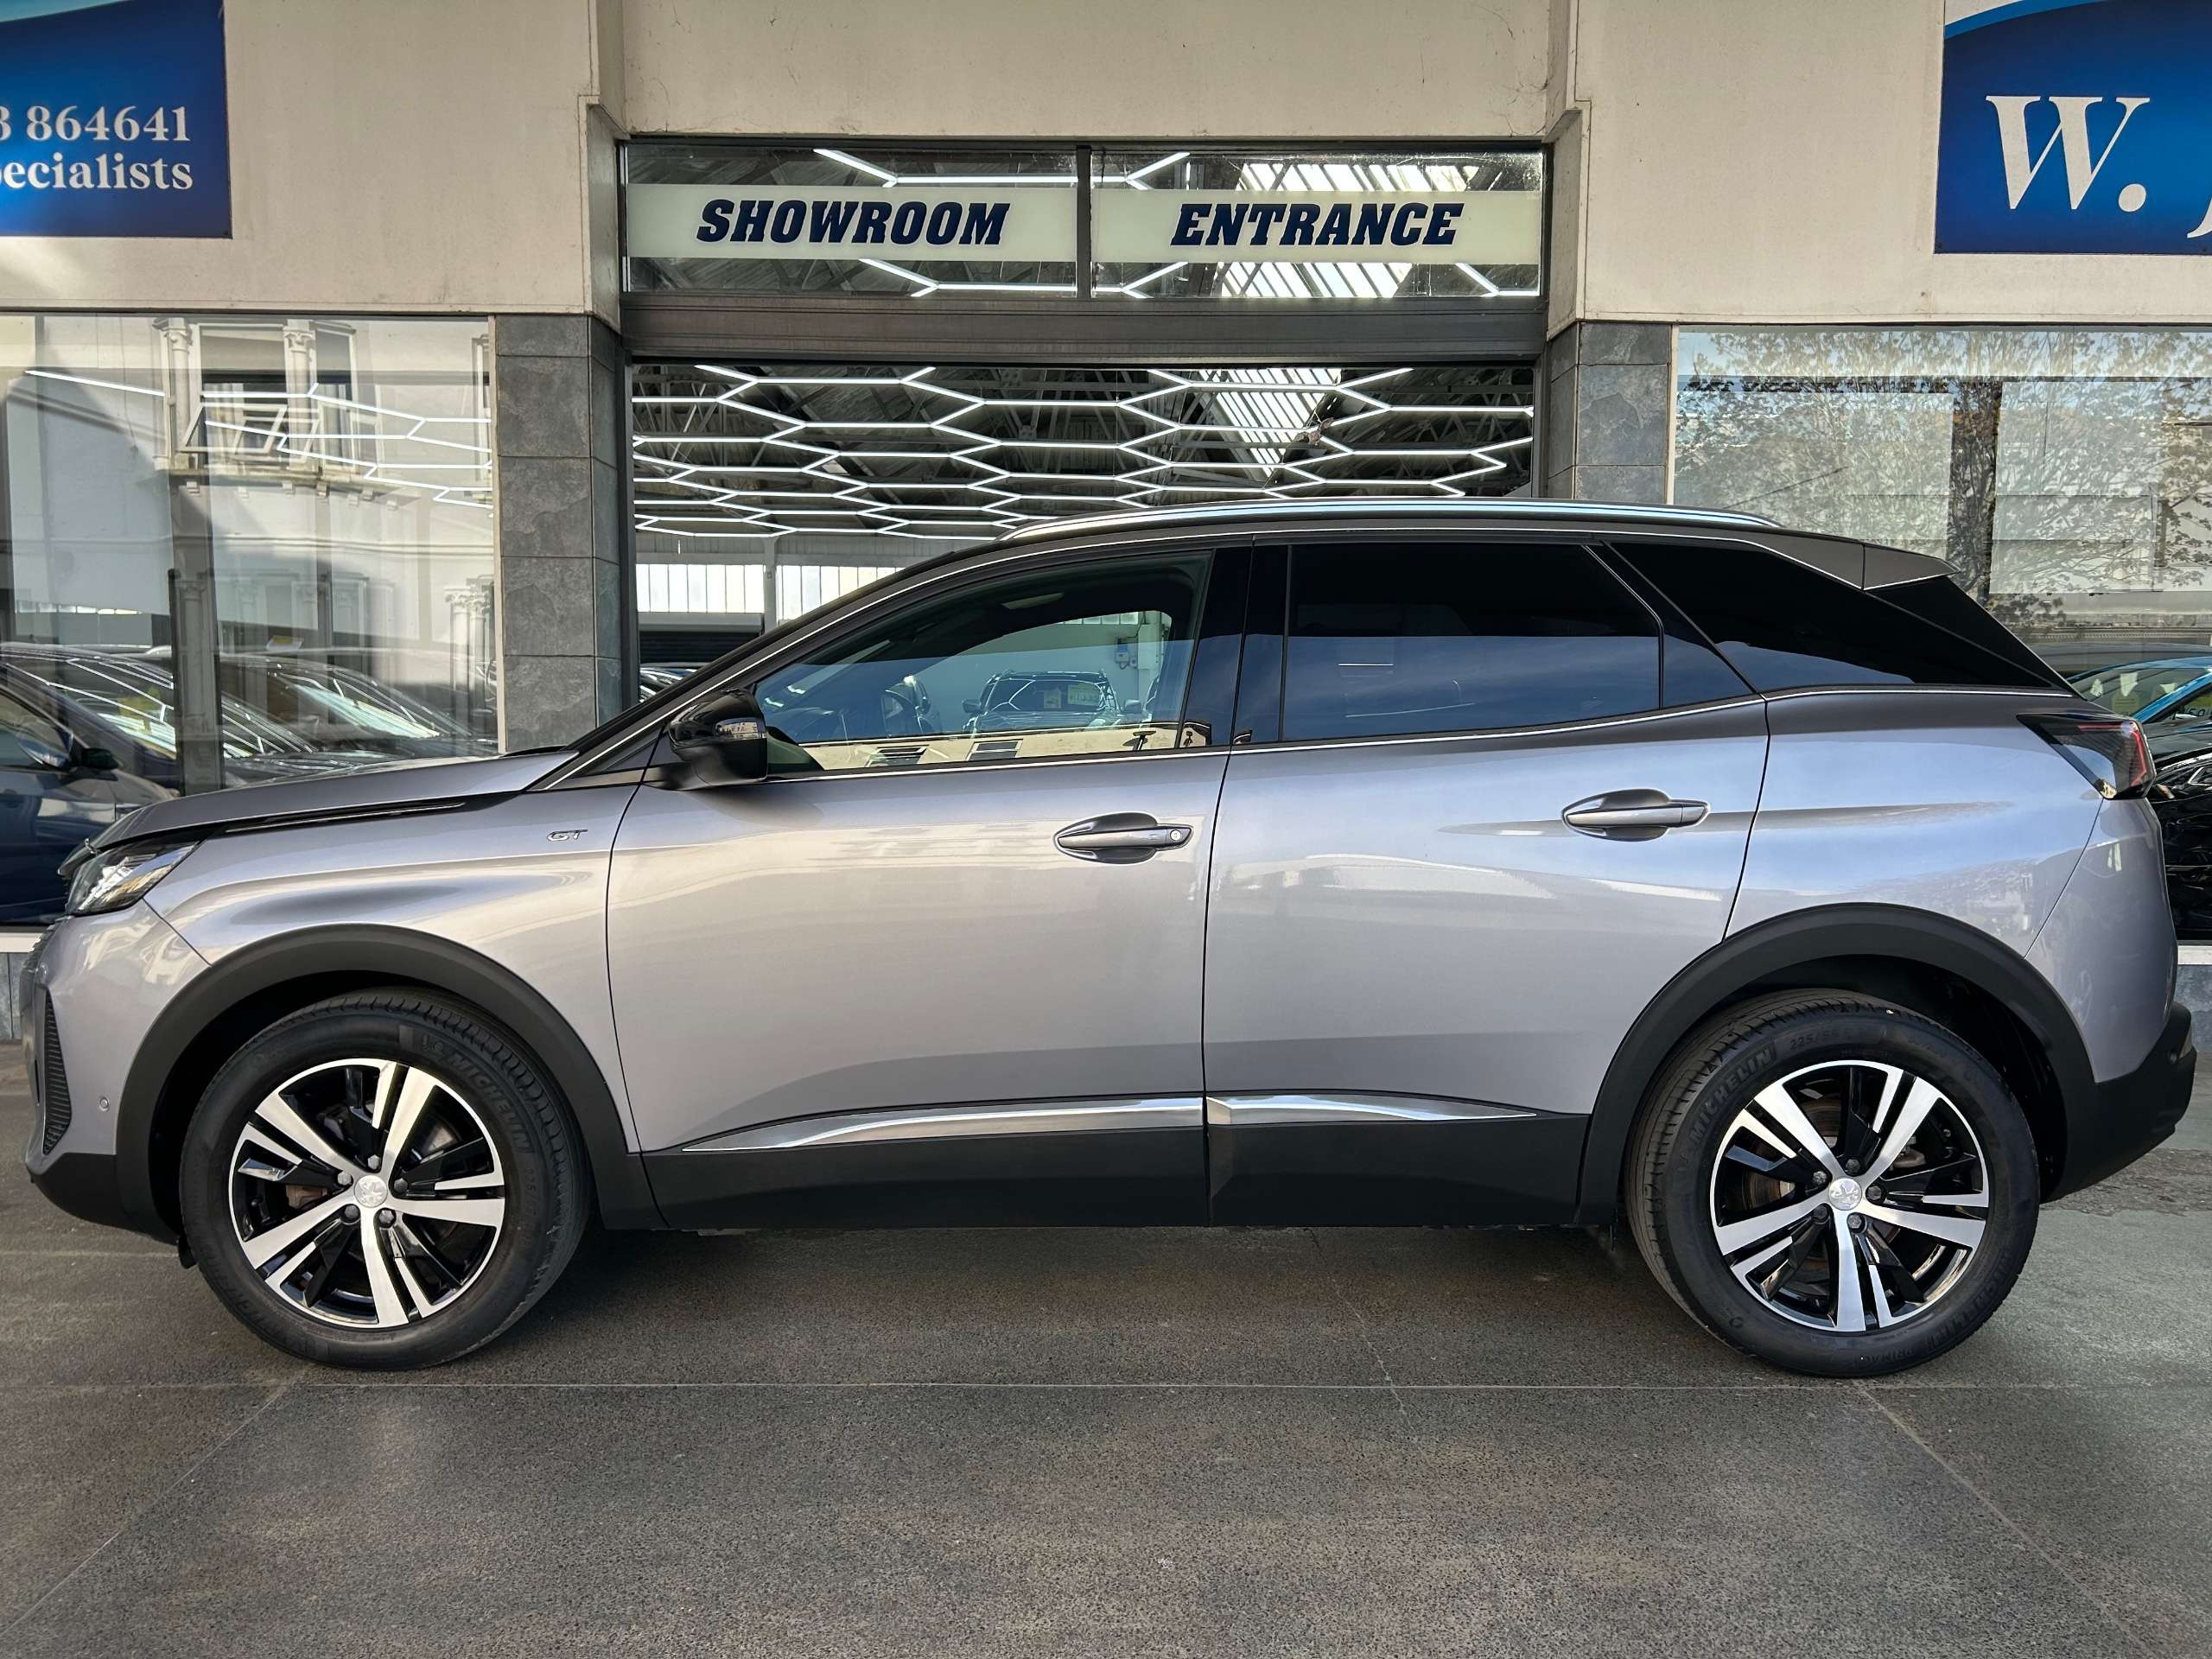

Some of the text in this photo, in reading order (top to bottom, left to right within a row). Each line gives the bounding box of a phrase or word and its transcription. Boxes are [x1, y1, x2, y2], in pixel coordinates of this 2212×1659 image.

[26, 105, 190, 142] 864641
[0, 152, 194, 189] ecialists
[1986, 95, 2151, 213] W.
[696, 199, 1465, 246] SHOWROOM ENTRANCE
[546, 829, 588, 842] GT
[447, 1050, 535, 1153] MICHELIN
[1688, 1046, 1775, 1145] MICHELIN
